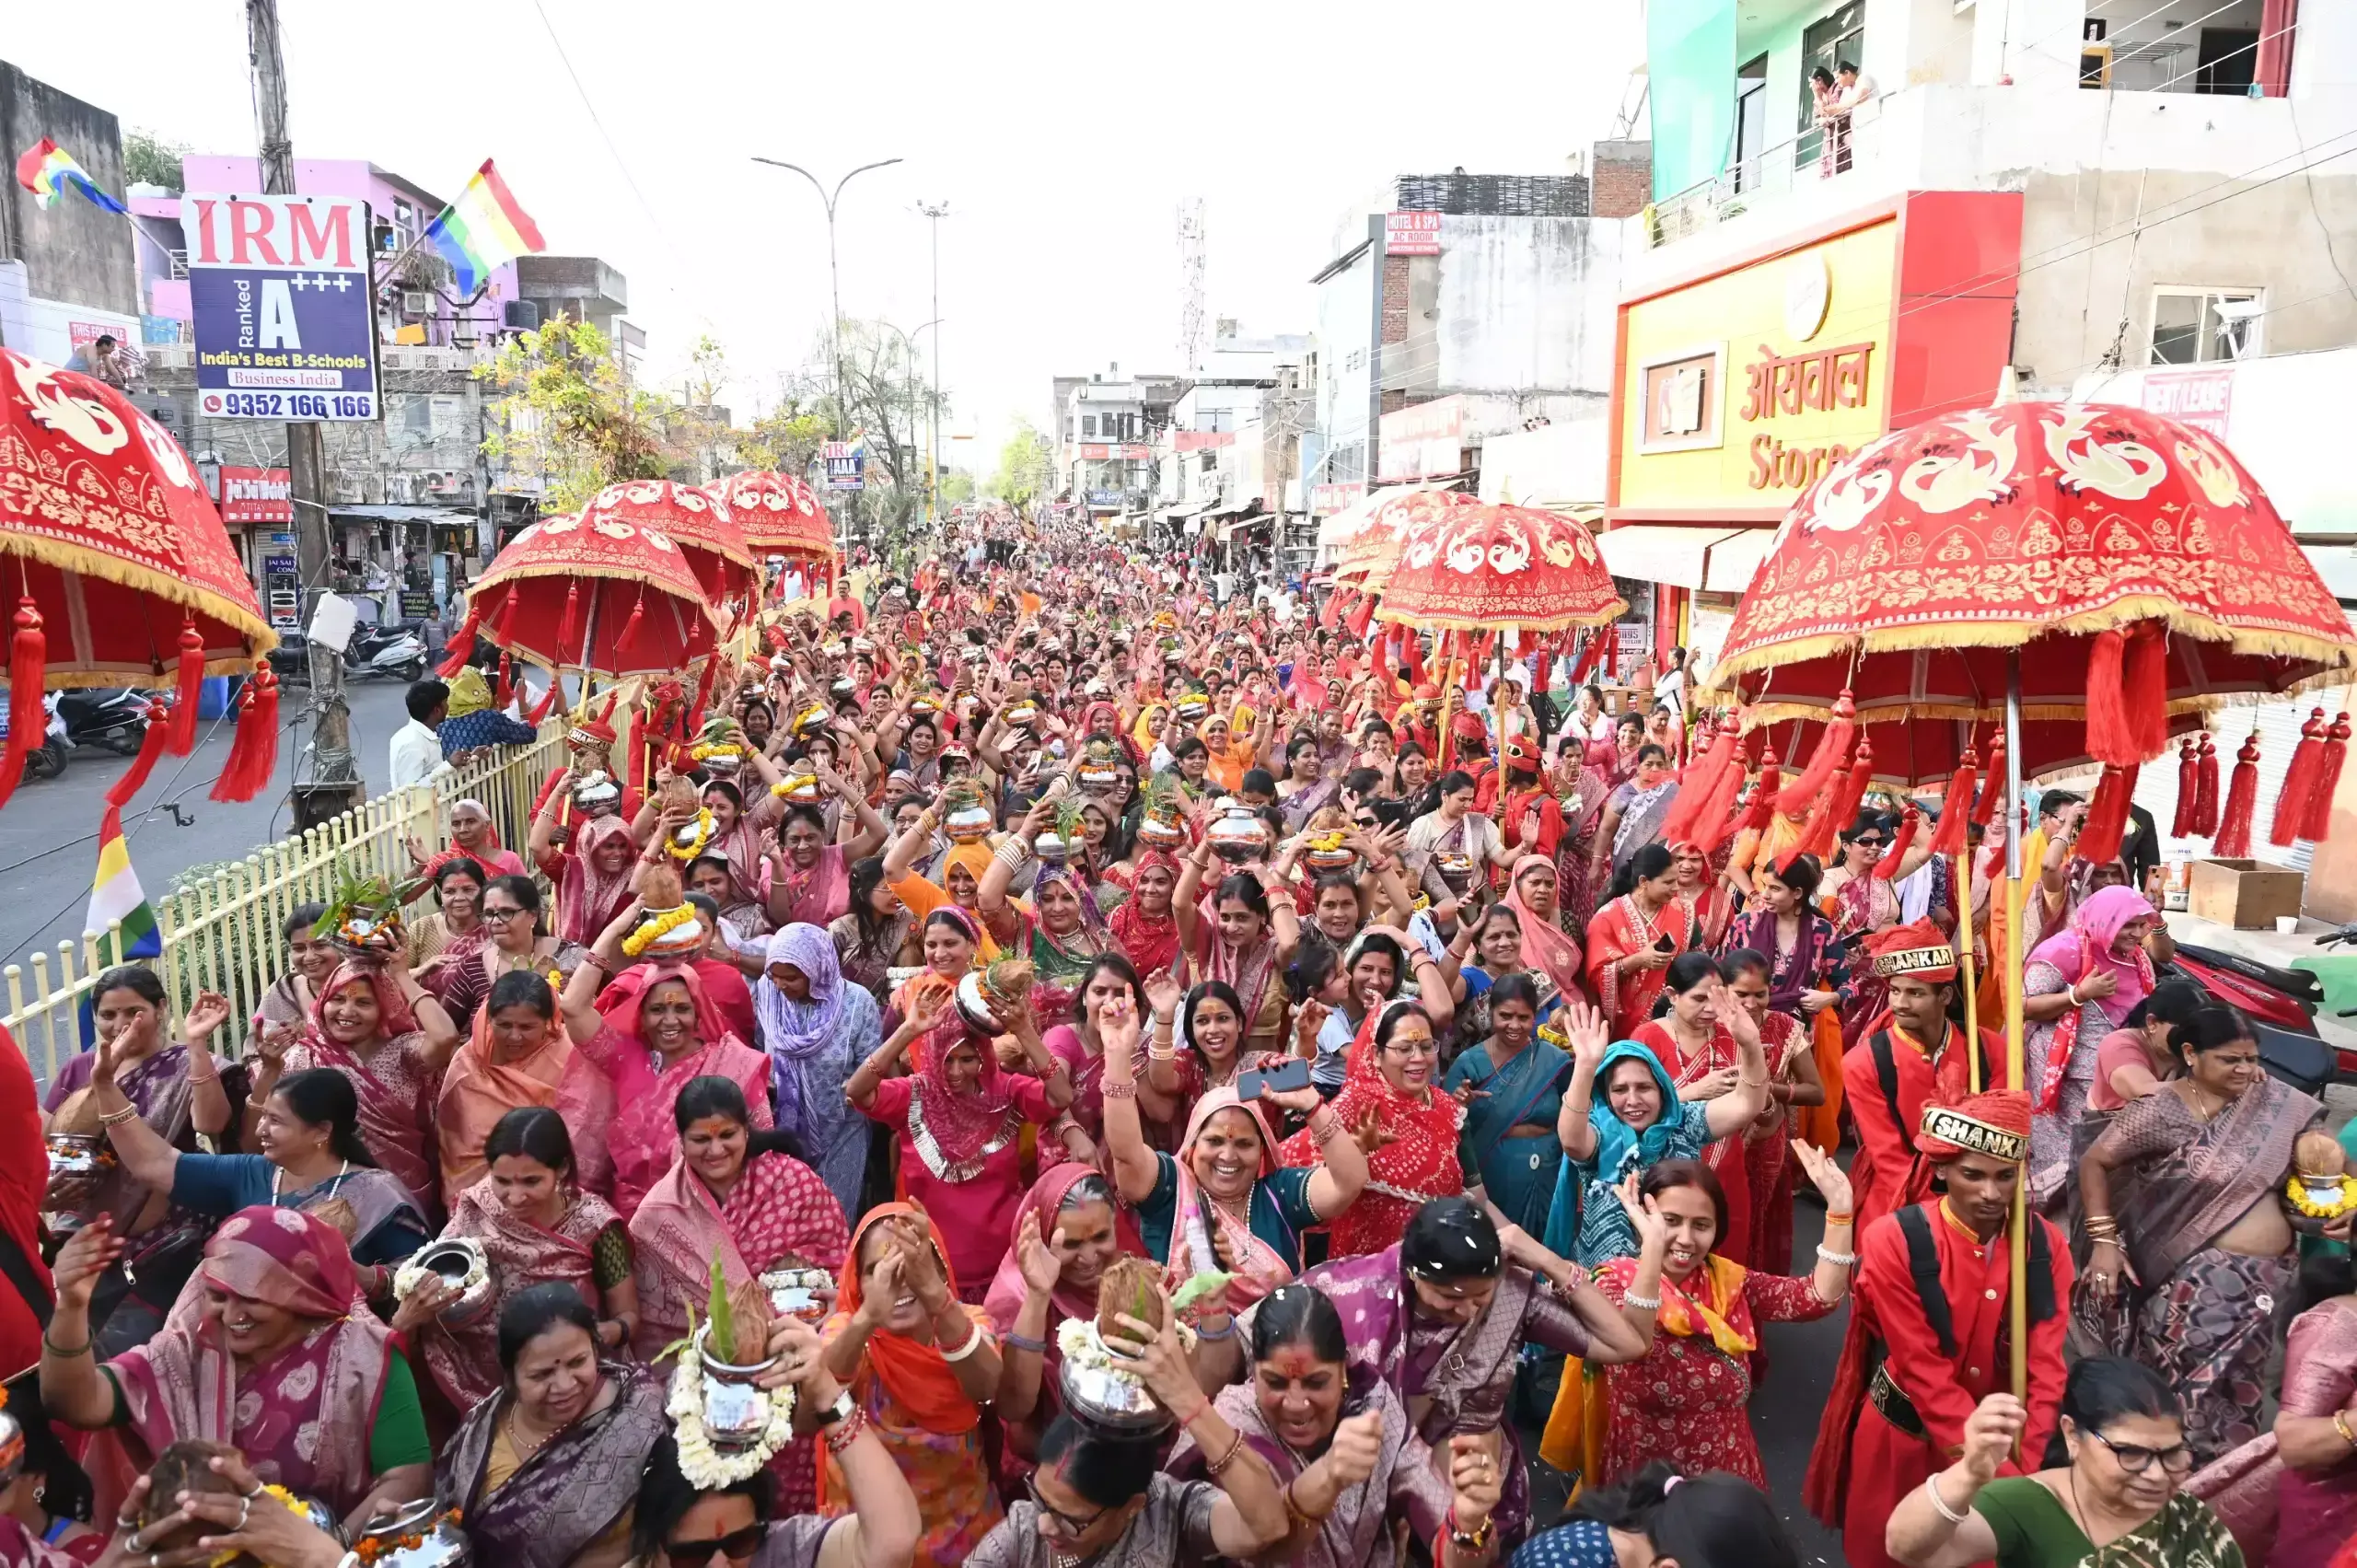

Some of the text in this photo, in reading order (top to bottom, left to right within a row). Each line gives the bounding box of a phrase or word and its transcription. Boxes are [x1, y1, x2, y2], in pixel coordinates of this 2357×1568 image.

[1388, 215, 1437, 229] HOTEL & SPA
[192, 200, 356, 268] IRM
[1394, 232, 1434, 242] AC ROOM
[233, 279, 255, 349] Ranked
[200, 351, 366, 369] India's Best B-Schools
[234, 371, 337, 387] Business India
[1739, 342, 1875, 422] ओसवाल
[226, 393, 371, 417] 9352 166 166
